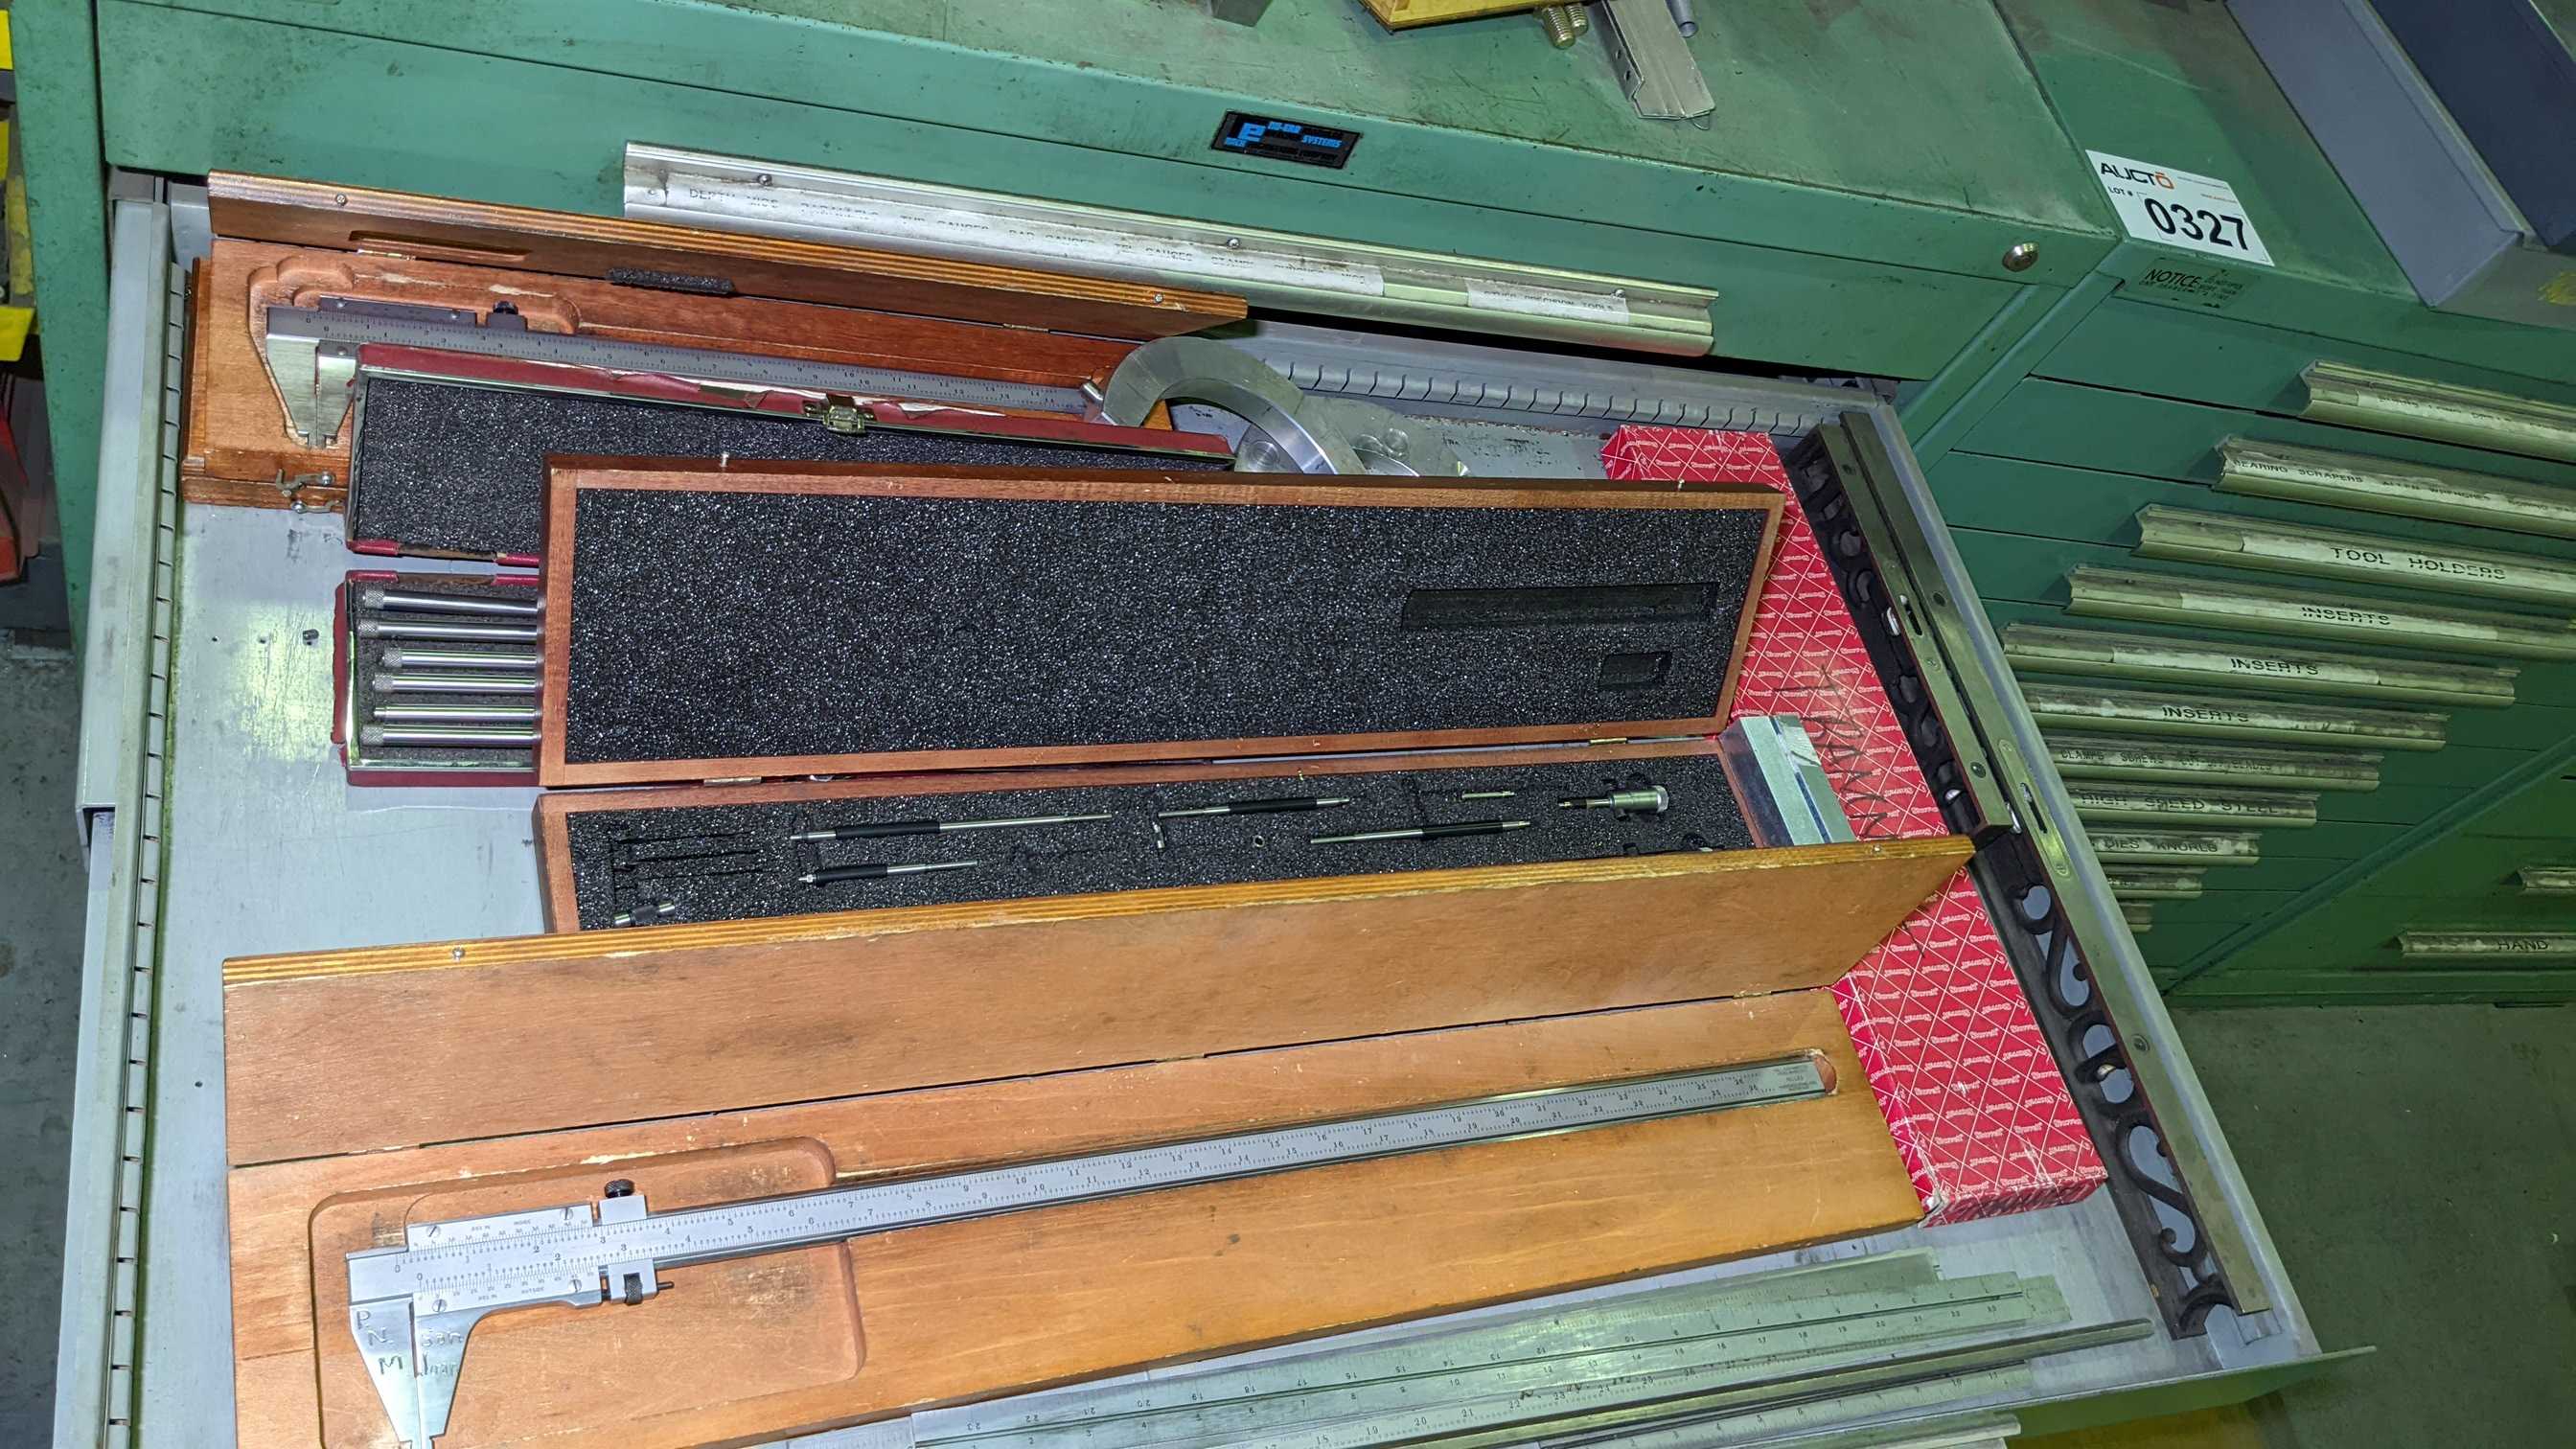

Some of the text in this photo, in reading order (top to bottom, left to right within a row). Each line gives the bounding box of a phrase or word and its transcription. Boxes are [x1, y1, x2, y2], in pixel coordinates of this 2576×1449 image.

[2143, 197, 2249, 251] 0327
[2145, 268, 2202, 288] NOTICE
[2331, 546, 2506, 581] TOOL HOLDERS
[2301, 606, 2391, 626] INSERTS
[2230, 657, 2319, 676] INSERTS
[2162, 706, 2250, 724] INSERTS
[2104, 839, 2141, 850] DIES
[2497, 939, 2549, 951] HAND
[356, 1310, 371, 1330] P
[379, 1355, 403, 1374] M
